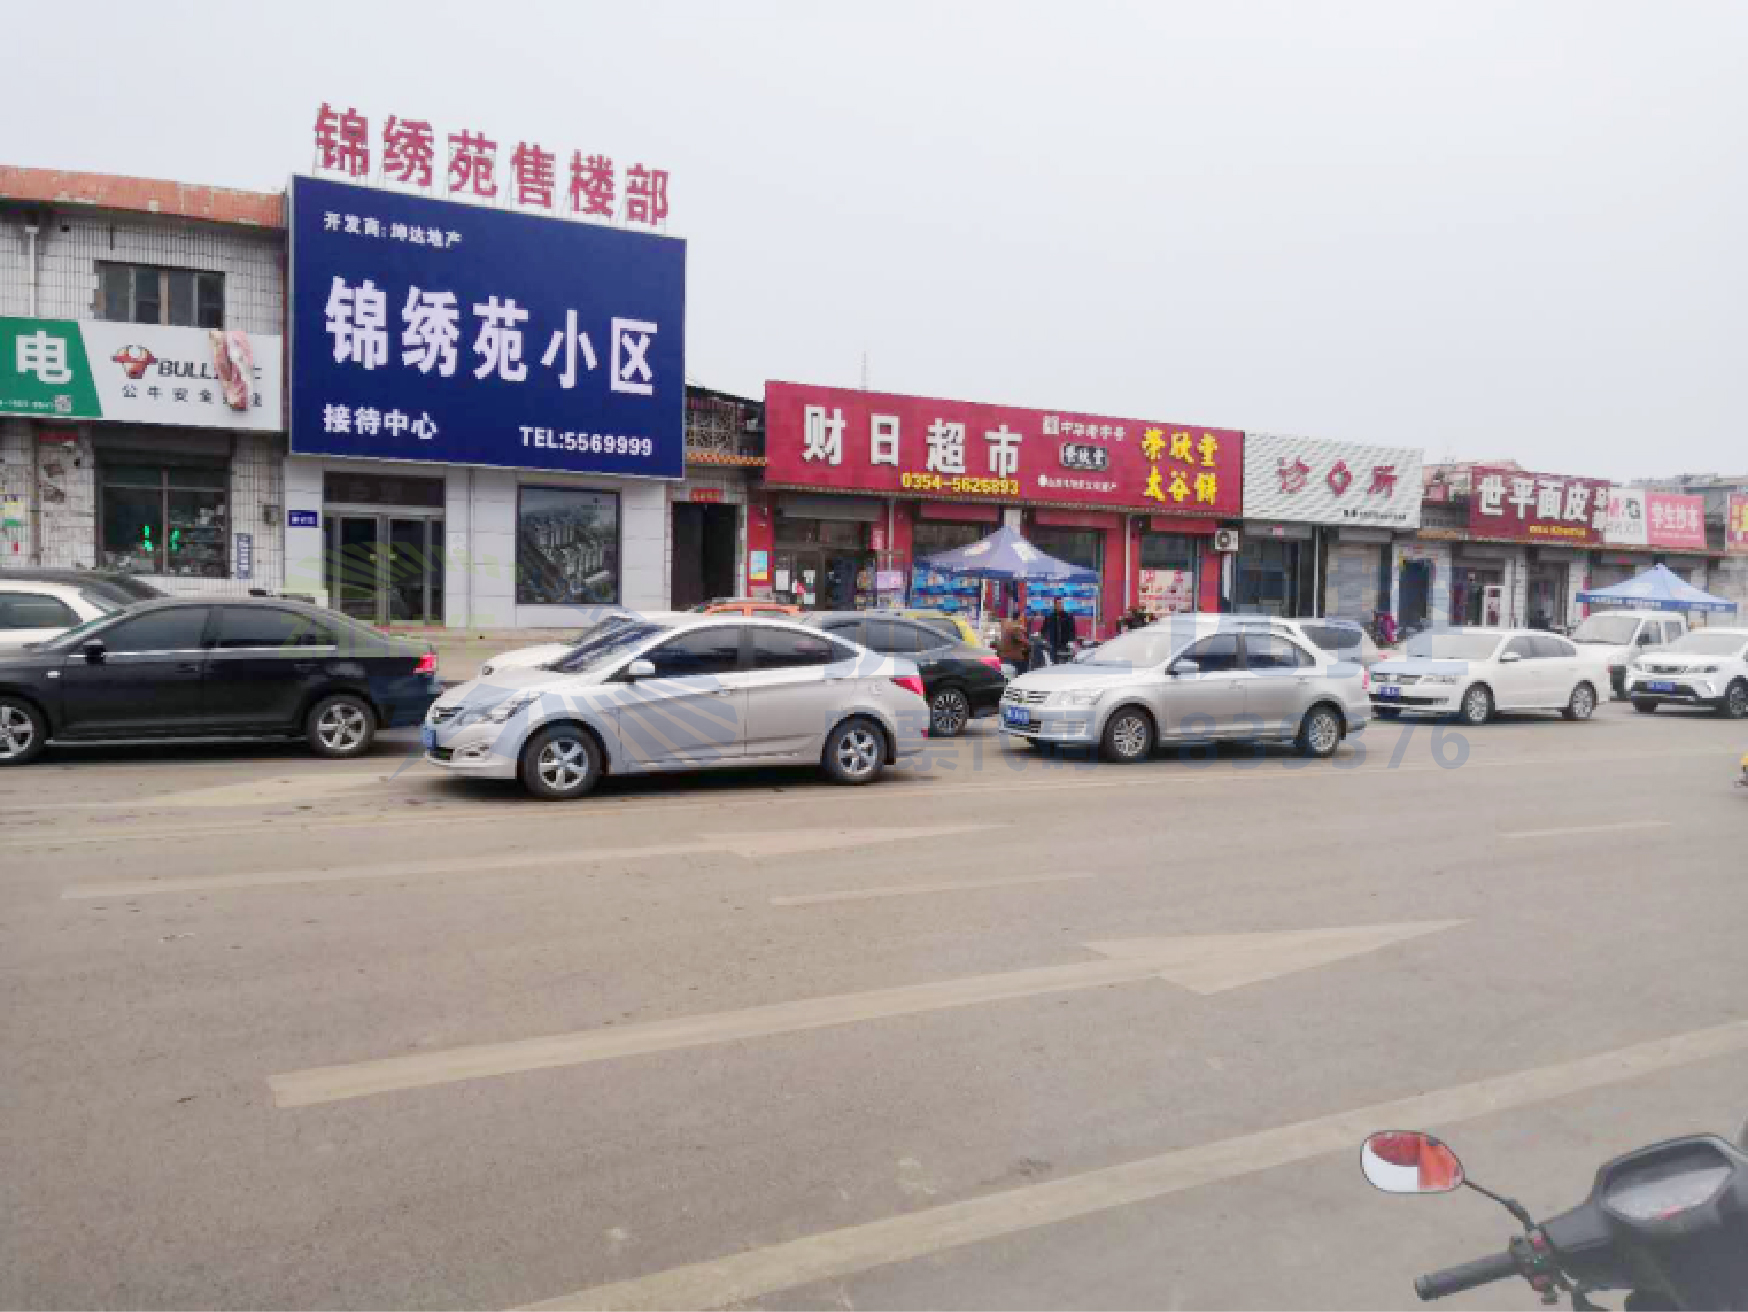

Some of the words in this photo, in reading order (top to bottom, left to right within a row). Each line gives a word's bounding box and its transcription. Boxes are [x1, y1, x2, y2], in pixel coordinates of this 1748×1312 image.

[314, 102, 670, 226] 锦绣苑售楼部
[15, 330, 72, 384] 电
[324, 275, 659, 396] 锦绣苑小区
[323, 403, 438, 440] 接待中心
[519, 426, 653, 456] TEL:5569999
[803, 403, 1023, 475] 财日超市
[1143, 465, 1218, 506] 太谷饼
[1476, 473, 1592, 522] 世平面皮
